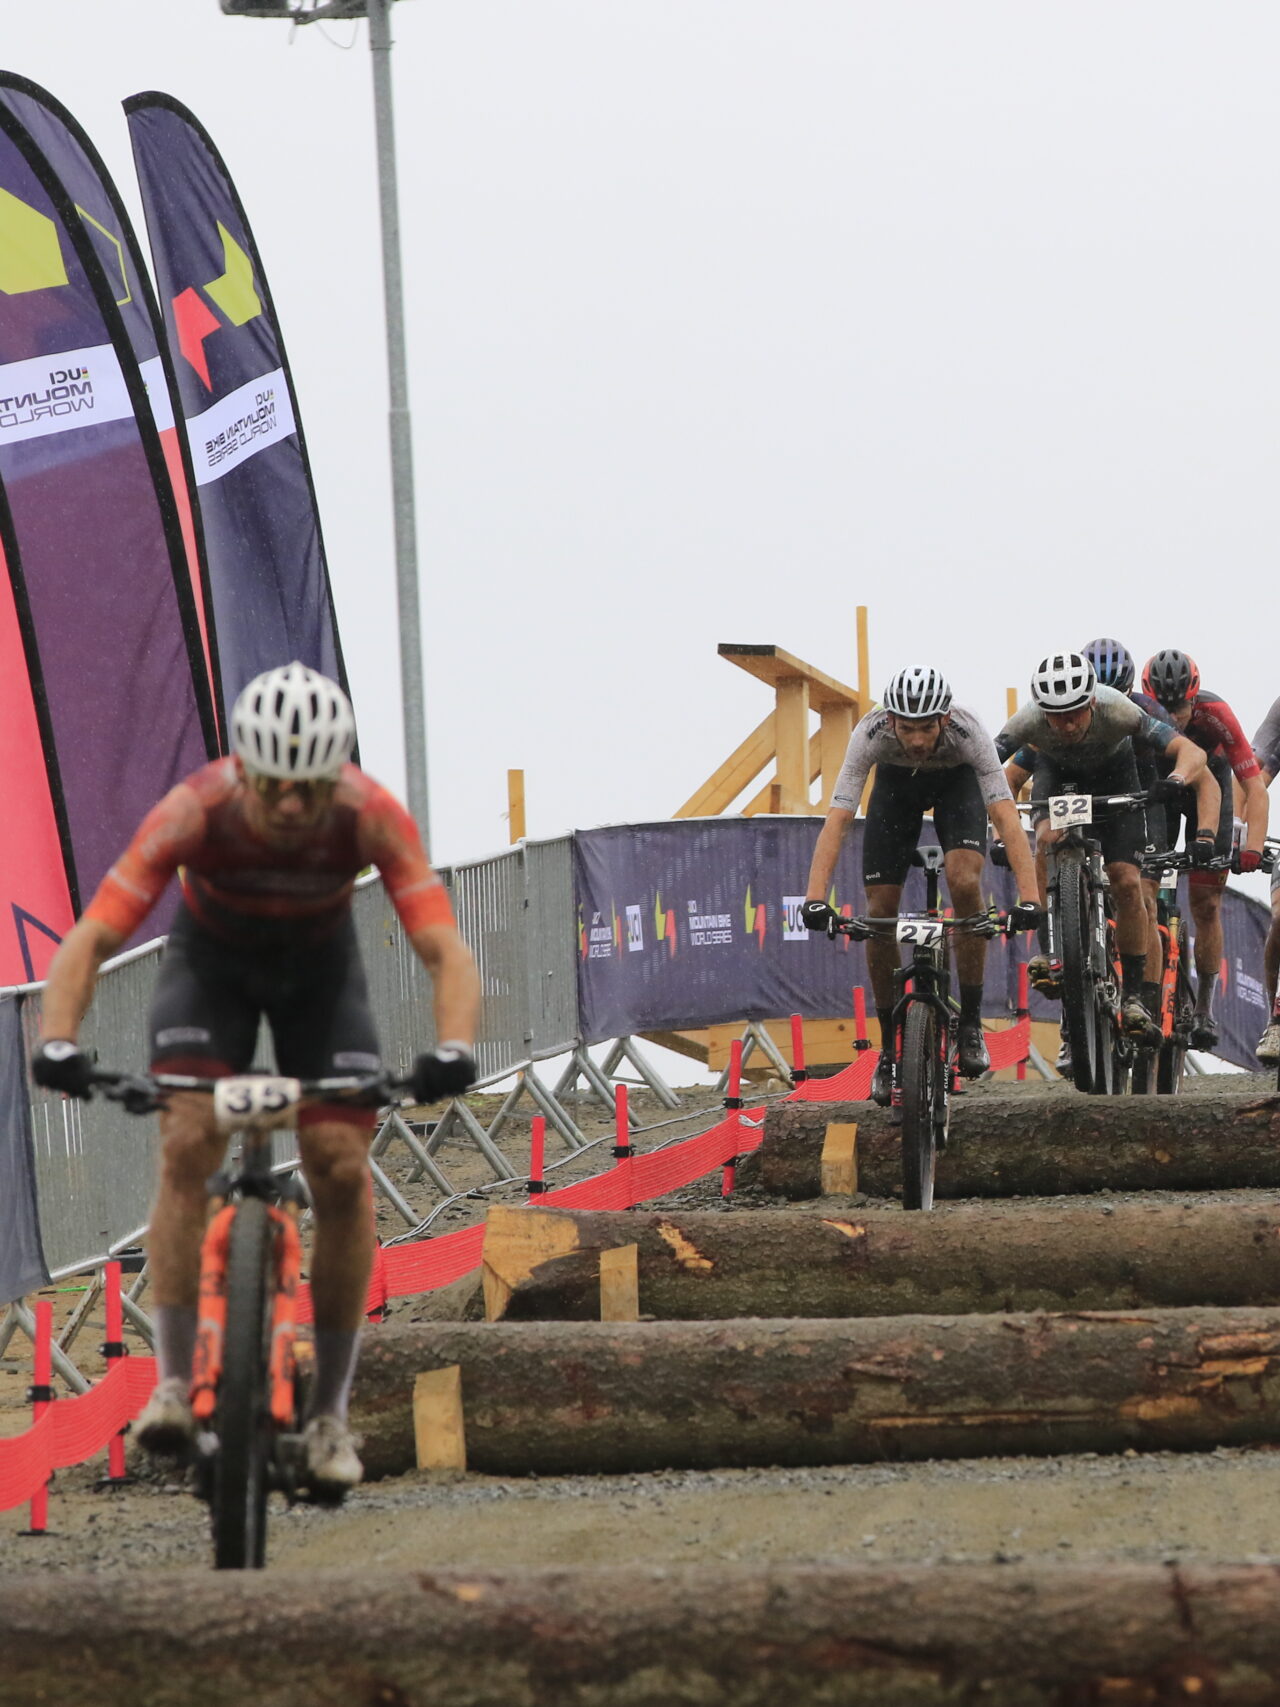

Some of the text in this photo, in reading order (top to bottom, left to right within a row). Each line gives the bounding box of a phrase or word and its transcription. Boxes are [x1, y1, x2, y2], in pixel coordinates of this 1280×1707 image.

[1053, 798, 1088, 817] 32
[901, 925, 937, 944] 27
[226, 1087, 290, 1115] 35
